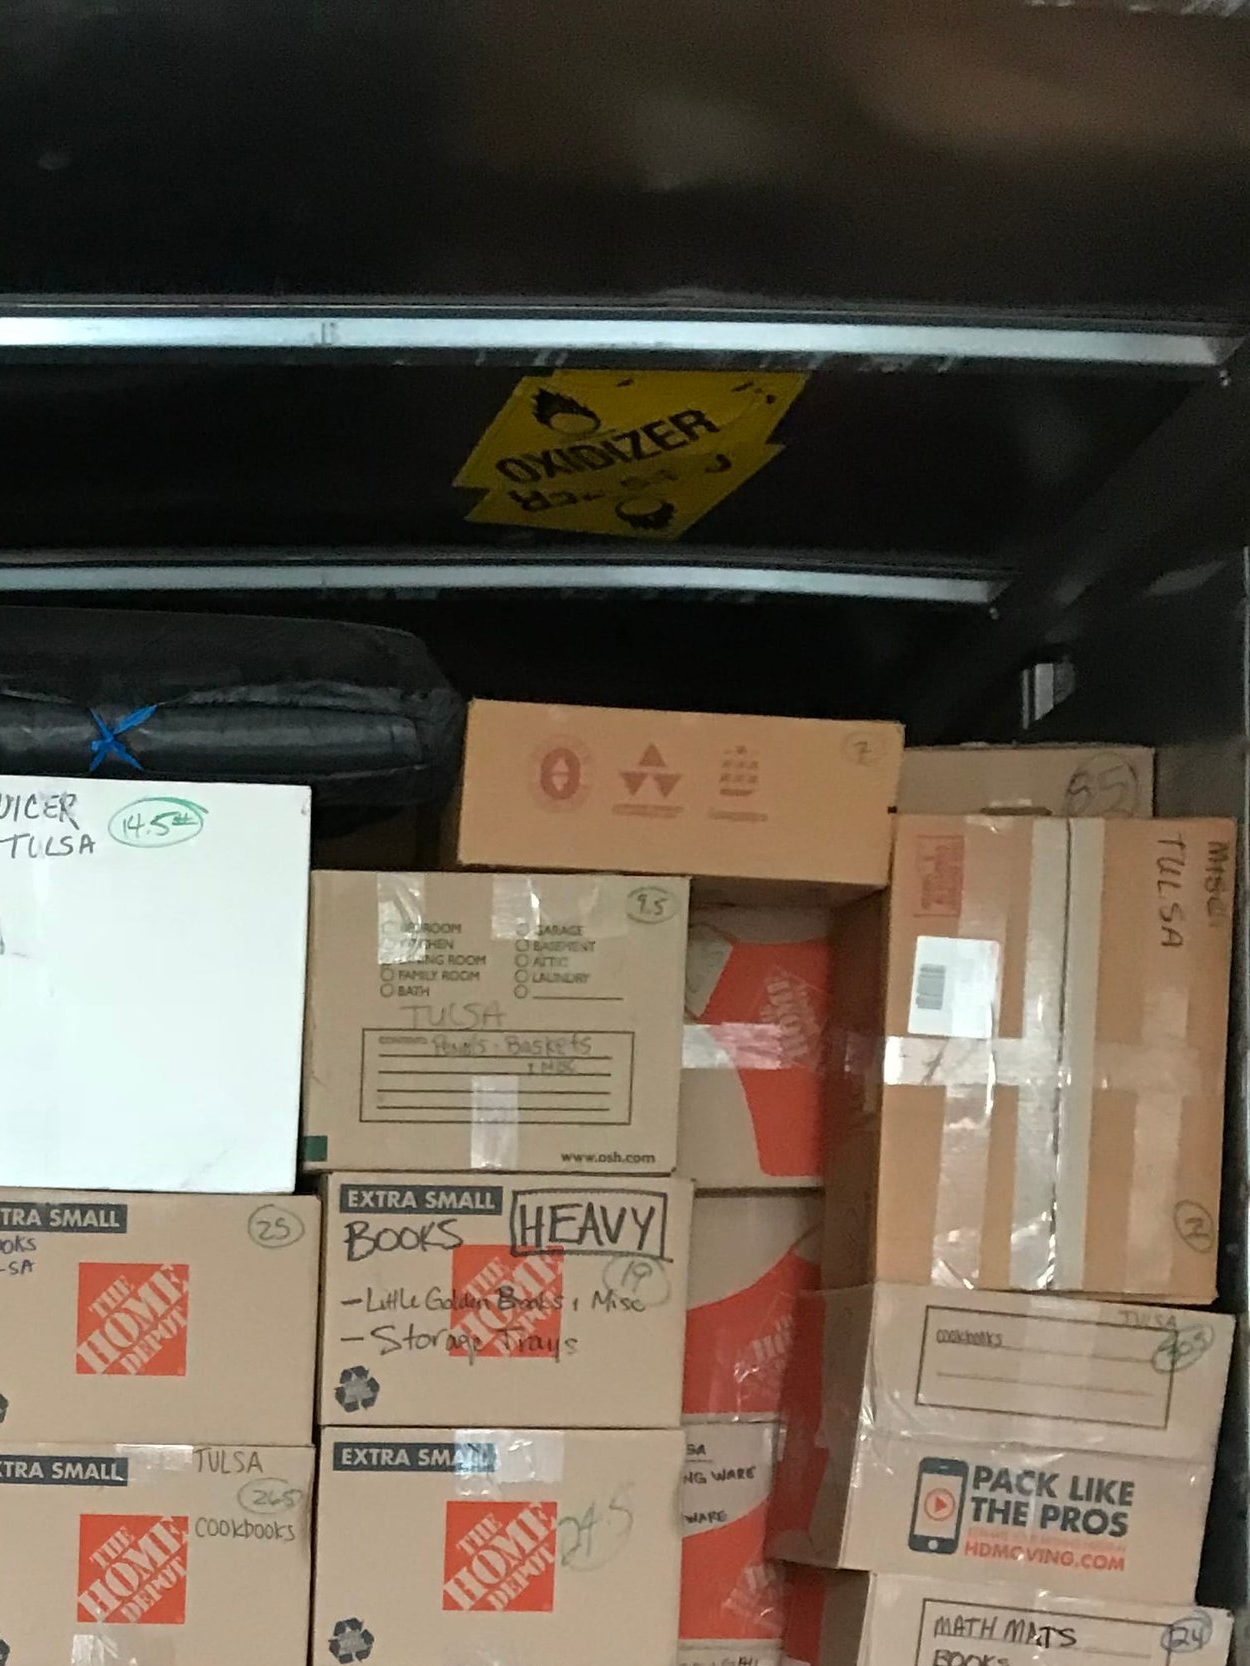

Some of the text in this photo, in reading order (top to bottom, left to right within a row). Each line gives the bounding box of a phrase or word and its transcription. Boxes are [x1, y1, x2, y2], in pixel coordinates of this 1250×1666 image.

[495, 408, 722, 483] OXIDIZER
[0, 832, 97, 859] TULSA
[1157, 834, 1187, 948] TULSA
[442, 971, 479, 981] ROOM
[561, 1152, 655, 1163] www.osh.com
[347, 1189, 496, 1209] EXTRA SMALL
[51, 1208, 121, 1228] SMALL
[519, 1202, 655, 1251] HEAVY
[88, 1275, 131, 1317] THE
[77, 1263, 189, 1375] HOME
[123, 1304, 187, 1375] DEPOT
[193, 1447, 263, 1474] TULSA
[971, 1464, 1134, 1507] PACK LIKE
[972, 1497, 1129, 1538] THE PROS
[964, 1541, 1126, 1573] HDMOVING.COM
[934, 1615, 997, 1640] MATH
